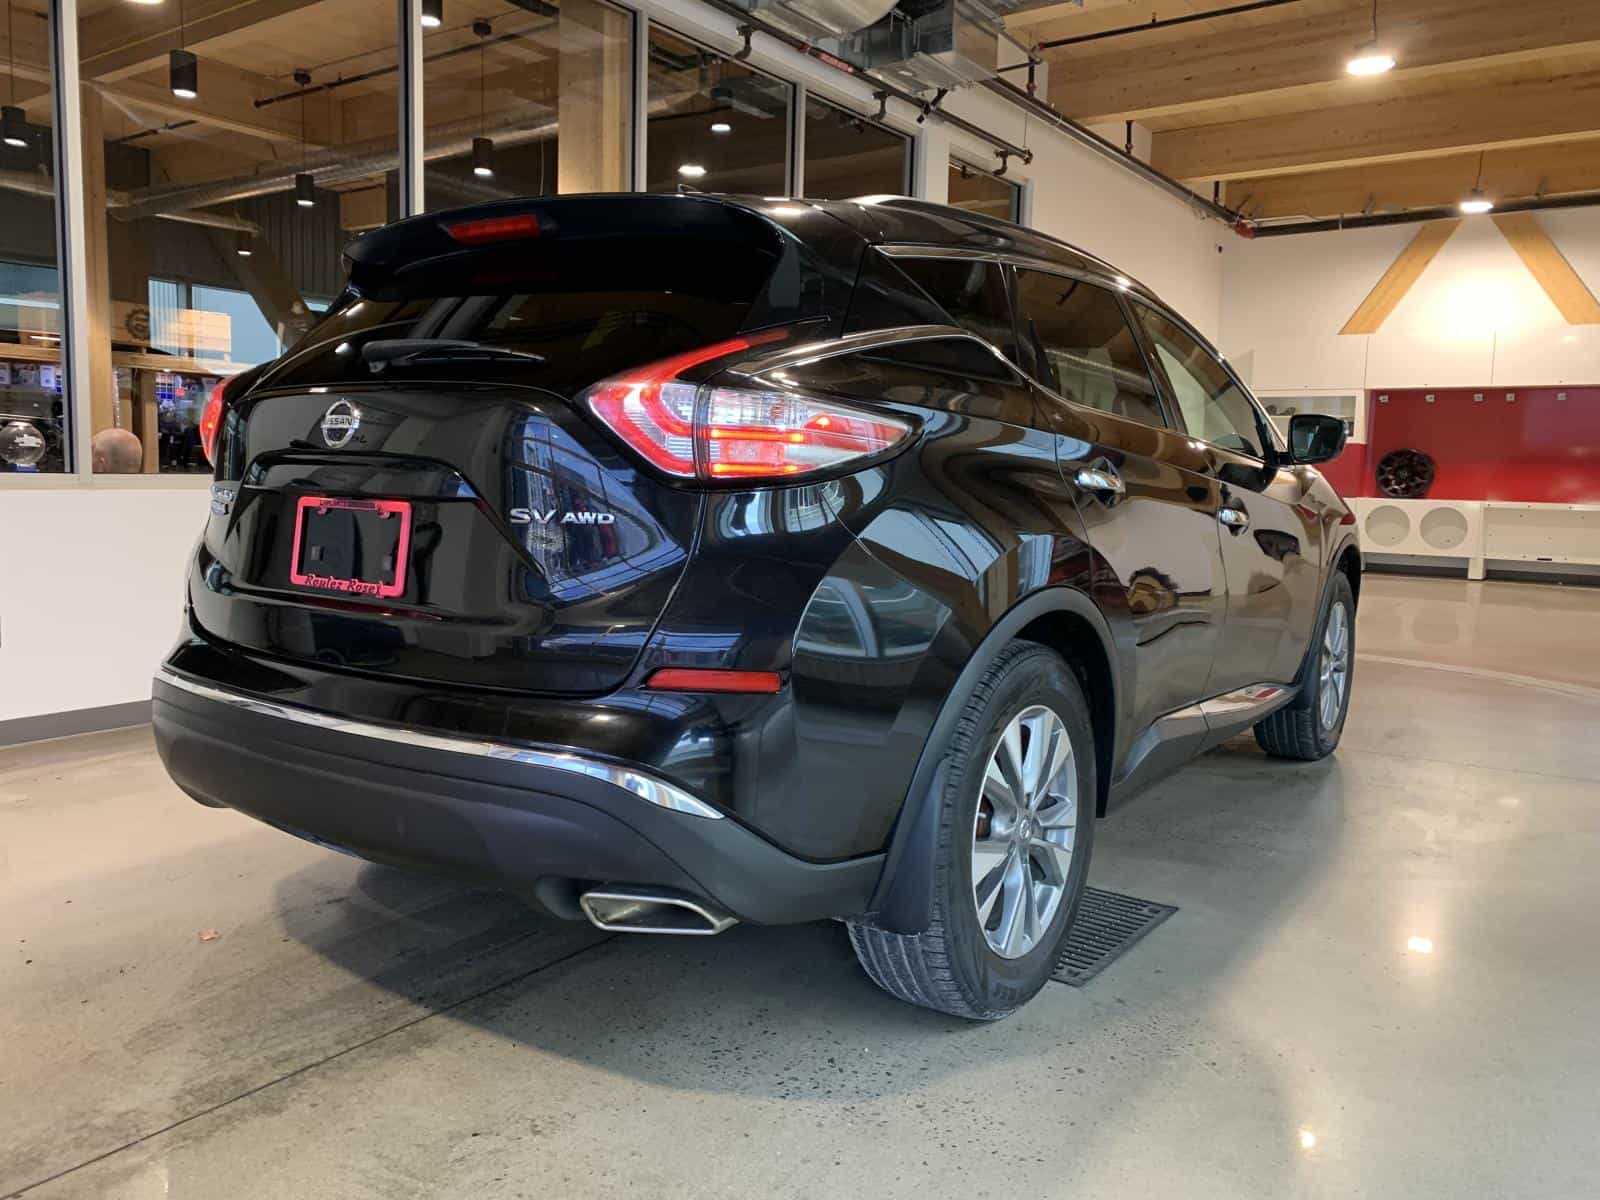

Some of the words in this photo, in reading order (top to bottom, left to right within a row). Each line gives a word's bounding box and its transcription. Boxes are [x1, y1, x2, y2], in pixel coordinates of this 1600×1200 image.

[509, 507, 557, 524] SV
[560, 511, 615, 525] AWD
[305, 573, 342, 591] Roulez
